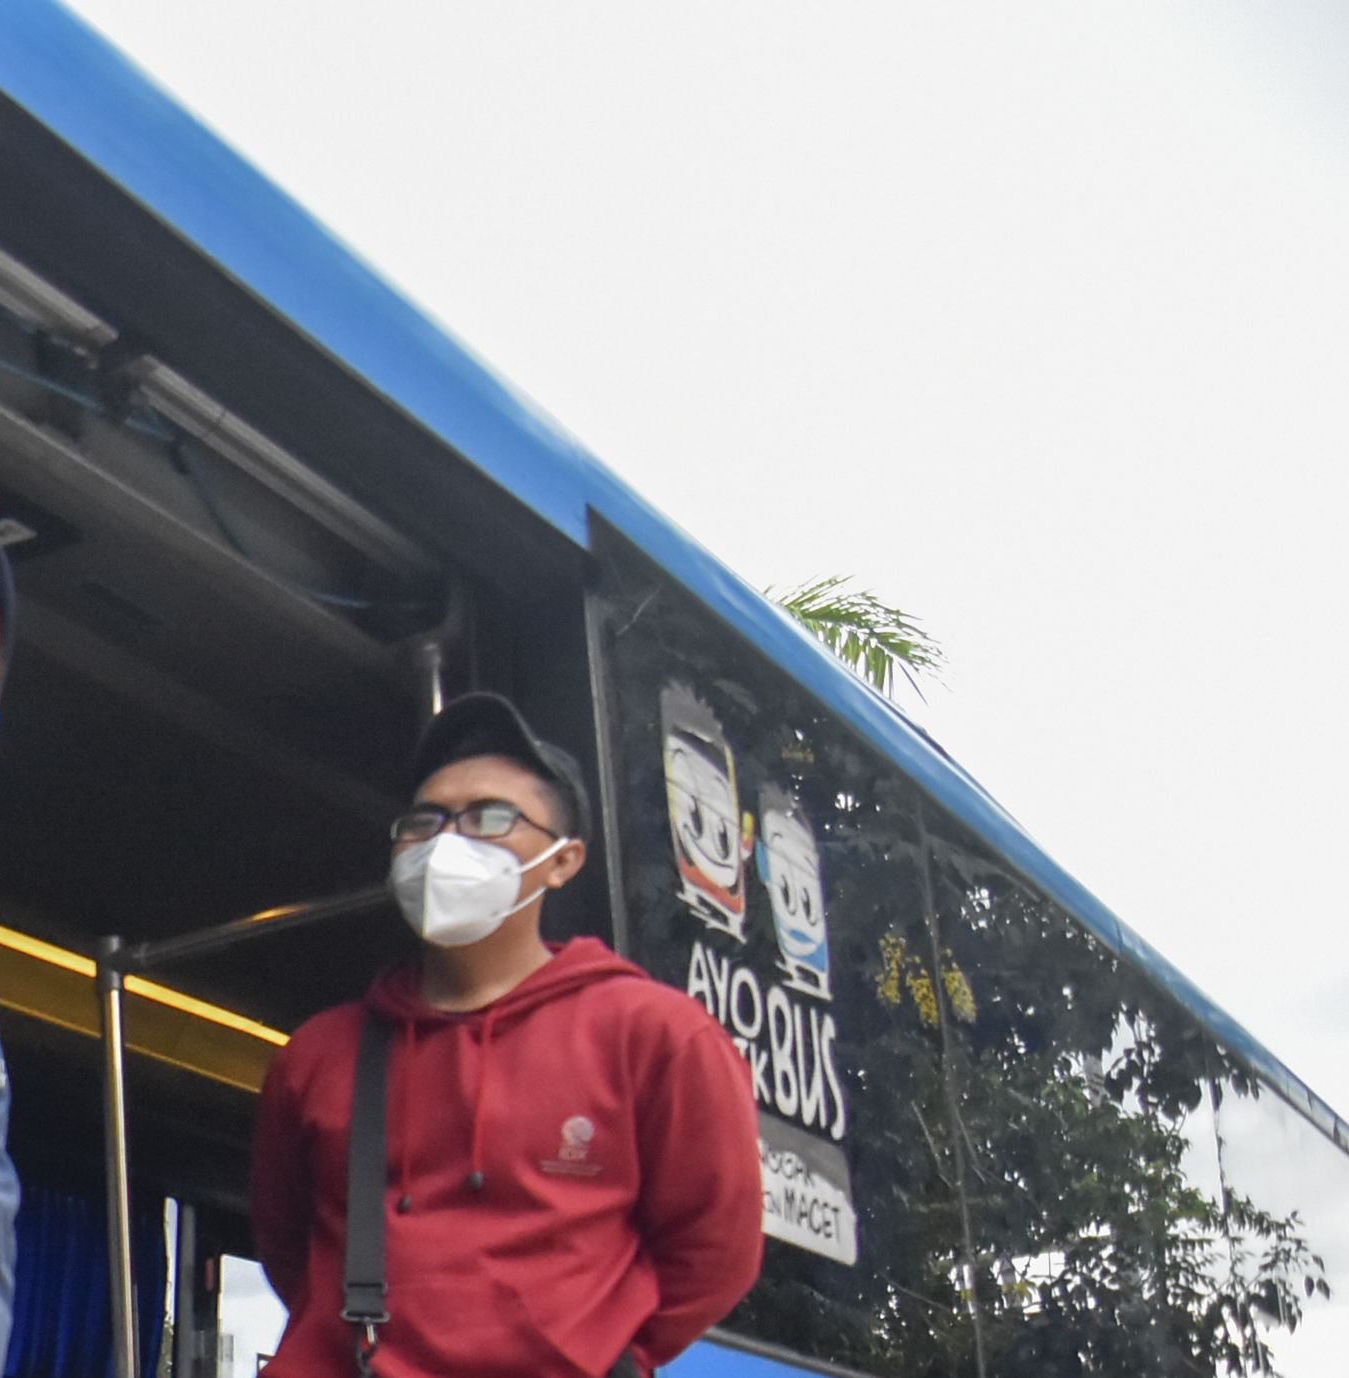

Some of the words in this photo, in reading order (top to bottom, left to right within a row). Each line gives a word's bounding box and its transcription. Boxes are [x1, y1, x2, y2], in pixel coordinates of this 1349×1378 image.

[688, 941, 763, 1039] AYO
[767, 986, 847, 1141] BUS
[783, 1186, 841, 1243] MACET
